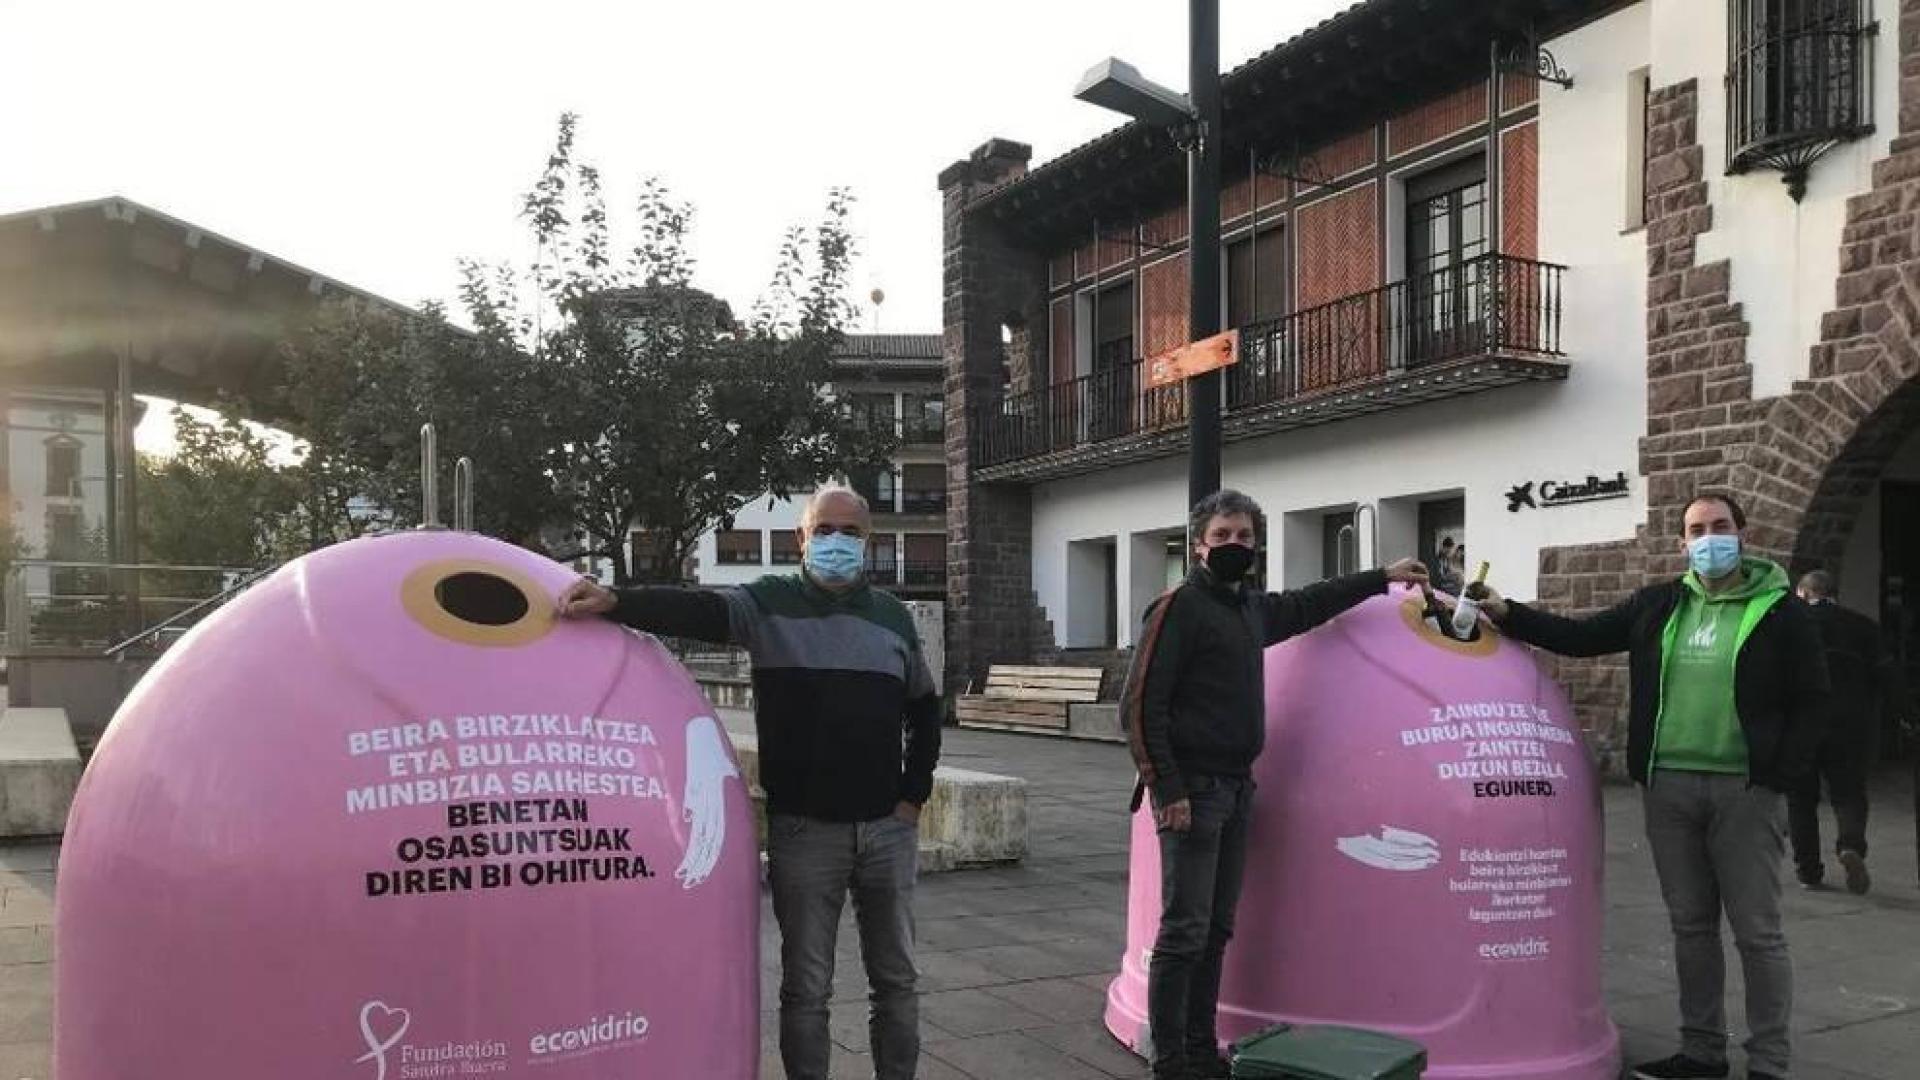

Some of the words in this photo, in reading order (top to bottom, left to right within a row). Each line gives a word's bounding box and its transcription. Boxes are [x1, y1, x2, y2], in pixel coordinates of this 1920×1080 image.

[1430, 702, 1504, 722] ZAINDU
[348, 718, 450, 756] BEIRA
[456, 714, 657, 746] BIRZIKLATZEA
[1401, 722, 1475, 746] BURUA
[389, 750, 451, 777] ETA
[458, 742, 636, 769] BULARREKO
[1438, 759, 1508, 779] DUZUN
[346, 772, 505, 813] MINBIZIA
[511, 771, 671, 800] SAIHESTEA.
[447, 799, 589, 829] BENETAN
[397, 827, 632, 864] OSASUNTSUAK
[366, 865, 473, 897] DIREN
[481, 864, 511, 889] BI
[519, 856, 656, 886] OHITURA.
[529, 1011, 649, 1054] ecovidrio
[401, 1040, 506, 1063] Fundación
